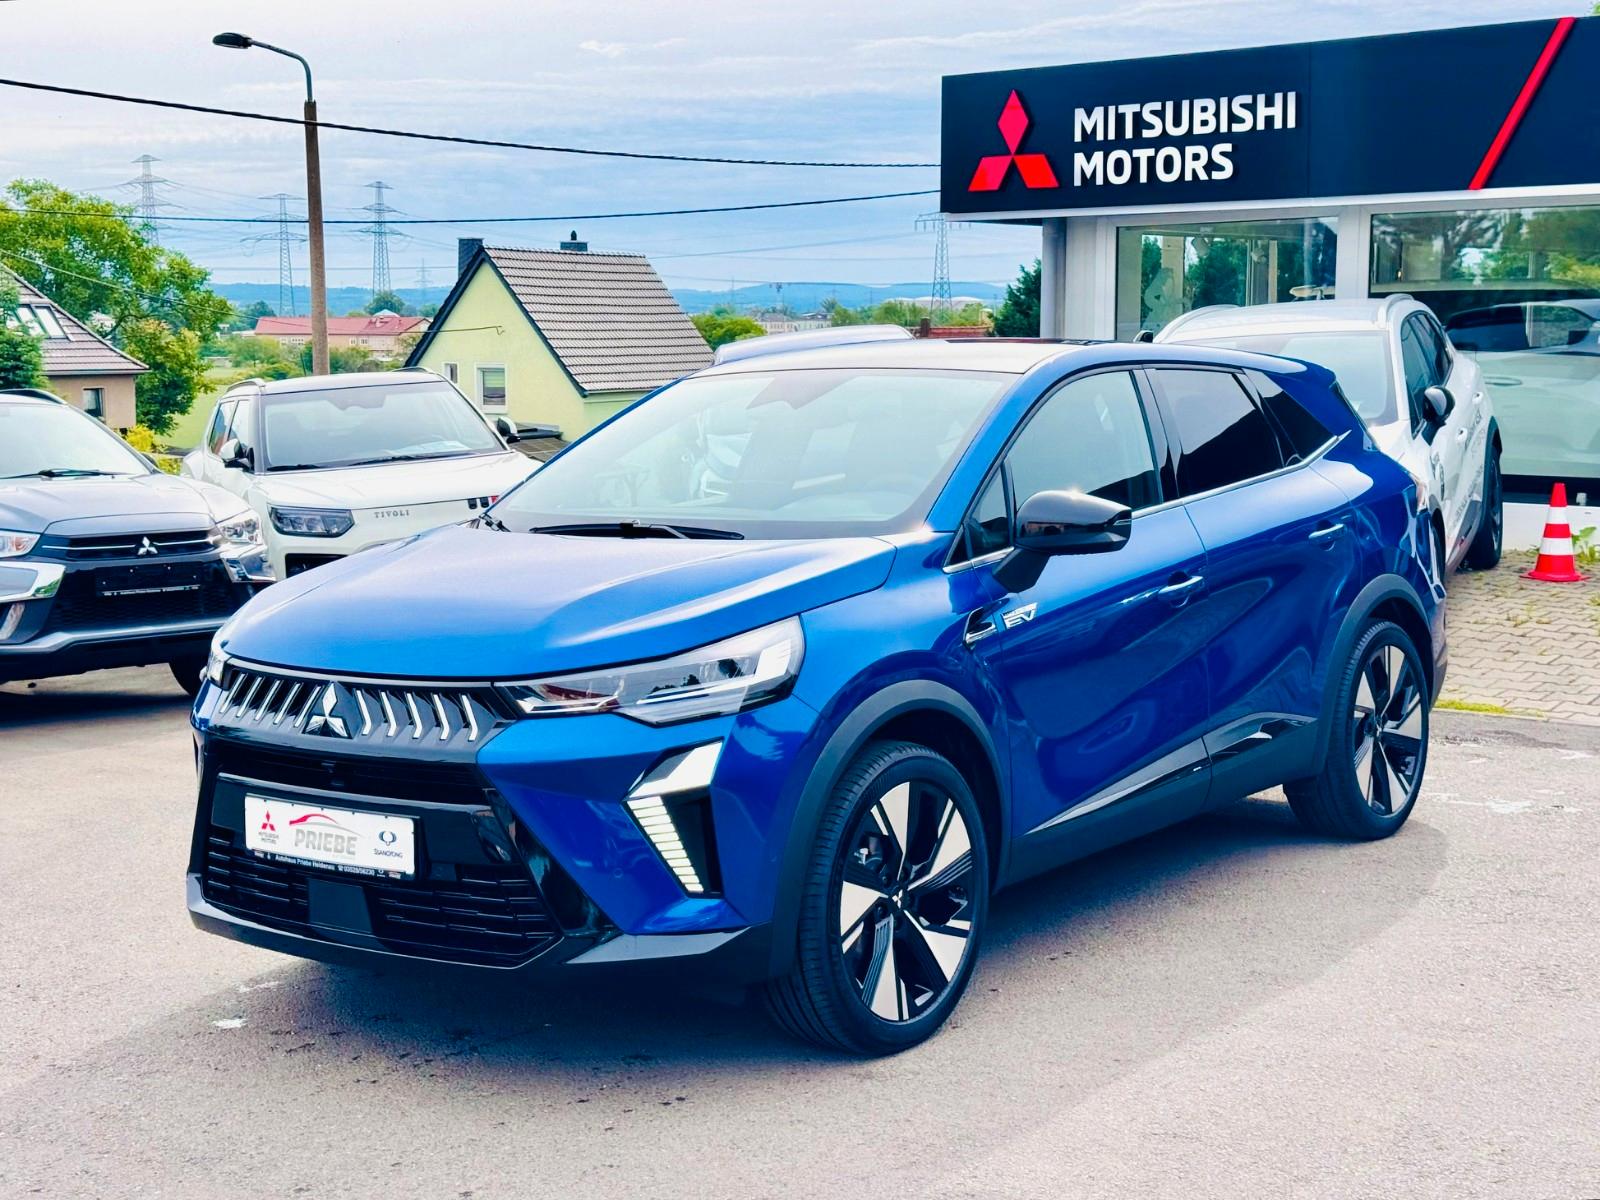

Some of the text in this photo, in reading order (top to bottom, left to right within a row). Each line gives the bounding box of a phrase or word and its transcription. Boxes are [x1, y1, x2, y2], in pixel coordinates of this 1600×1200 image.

[1073, 91, 1297, 142] MITSUBISHI
[1073, 143, 1234, 187] MOTORS
[374, 509, 410, 519] TIVOLI
[1003, 604, 1038, 629] EV
[294, 829, 357, 855] PRIEBE
